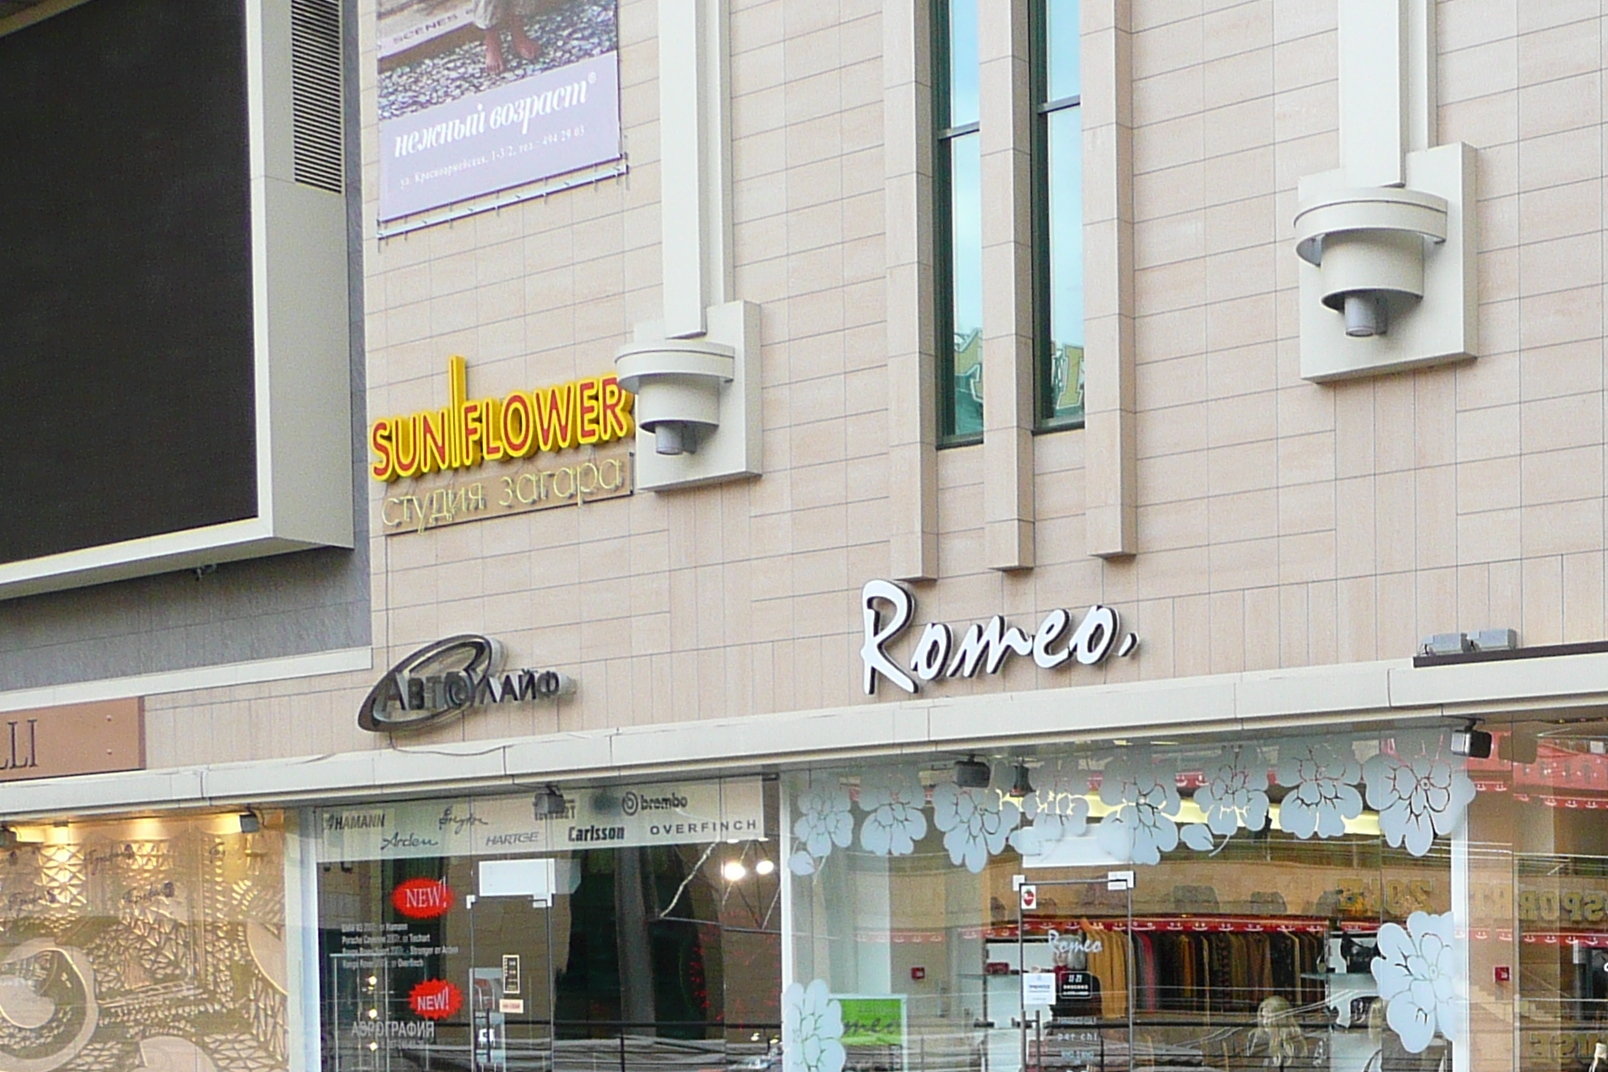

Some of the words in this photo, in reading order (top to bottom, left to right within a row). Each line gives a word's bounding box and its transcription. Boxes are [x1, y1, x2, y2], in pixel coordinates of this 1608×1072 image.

[394, 103, 486, 158] нежный
[381, 481, 486, 535] студия
[498, 458, 624, 508] загара
[640, 792, 688, 811] brembo
[567, 824, 625, 842] Carlsson
[650, 819, 757, 836] OVERFINCH
[380, 831, 439, 850] Arden
[486, 831, 540, 847] HARTGE
[404, 876, 447, 909] NEW!
[1048, 929, 1103, 955] Romeo
[417, 986, 450, 1011] NEW!
[351, 1020, 435, 1038] АЭРОГРАФИЯ
